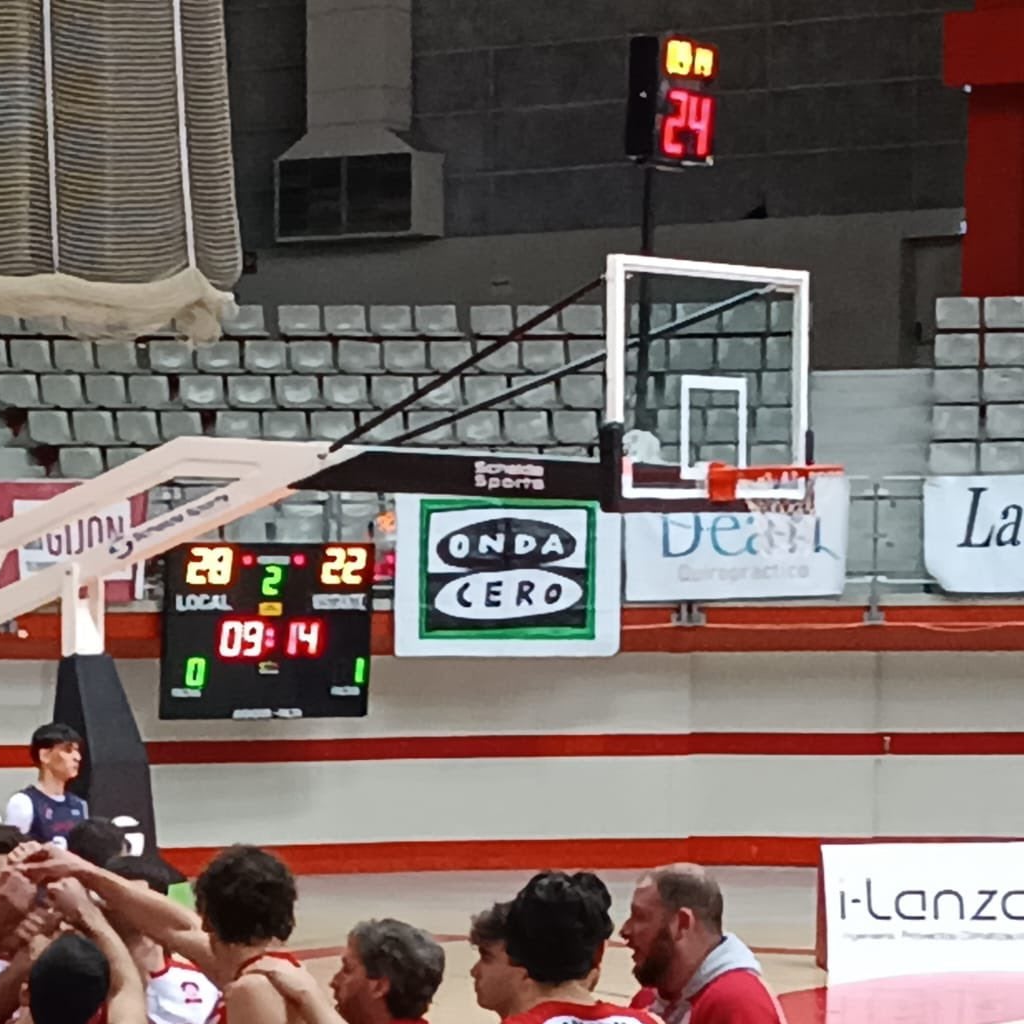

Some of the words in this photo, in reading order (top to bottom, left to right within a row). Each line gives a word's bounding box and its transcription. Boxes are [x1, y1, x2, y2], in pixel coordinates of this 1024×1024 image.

[663, 90, 711, 155] 24
[448, 533, 564, 559] ONDA
[185, 546, 234, 585] 28
[261, 565, 282, 596] 2
[320, 546, 367, 585] 22
[175, 593, 233, 611] LOCAL
[456, 580, 563, 607] CERO
[184, 656, 206, 688] 0
[354, 656, 366, 684] 1
